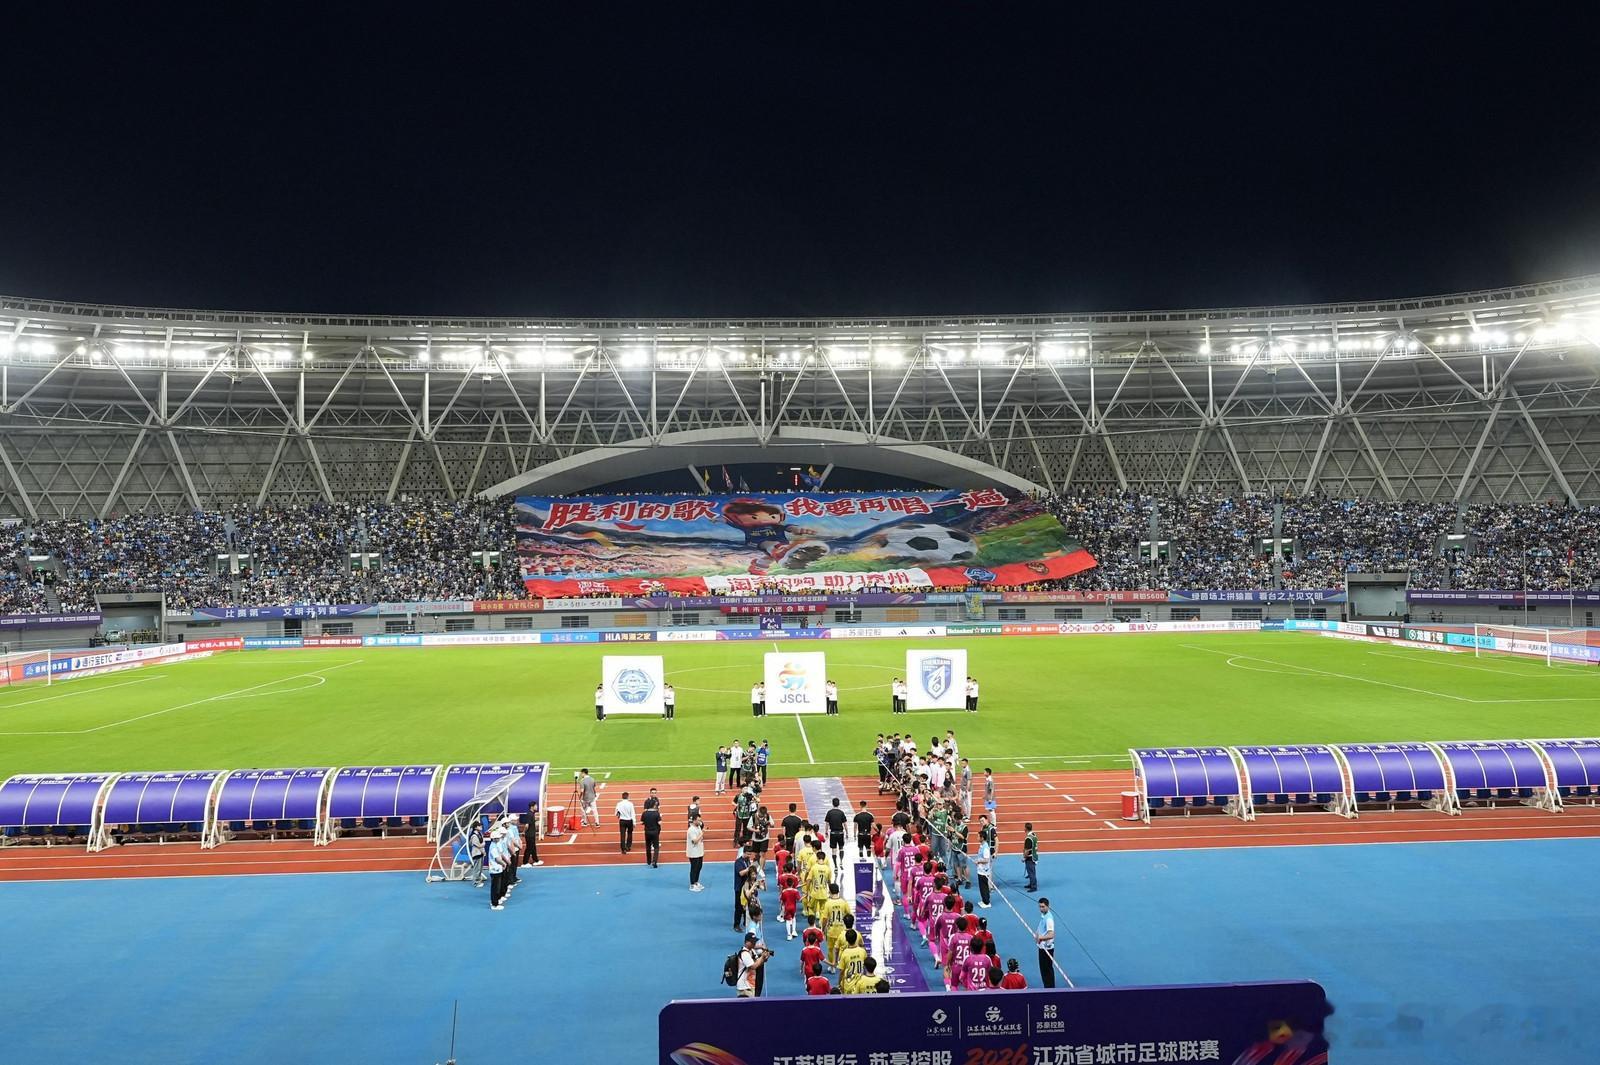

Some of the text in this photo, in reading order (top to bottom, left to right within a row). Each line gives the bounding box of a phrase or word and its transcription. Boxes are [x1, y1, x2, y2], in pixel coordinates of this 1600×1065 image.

[541, 488, 1008, 530] 胜利的歌 我要再唱一遍
[1259, 592, 1323, 601] 看台之上见文明
[225, 609, 270, 618] 比赛第一
[780, 693, 810, 704] JSCL
[904, 856, 915, 867] 35
[832, 910, 841, 922] 14
[947, 925, 953, 937] 7
[956, 945, 969, 959] 26
[972, 967, 986, 982] 29
[962, 1043, 1028, 1065] 2026
[1033, 1041, 1220, 1065] 江苏省城市足球联赛
